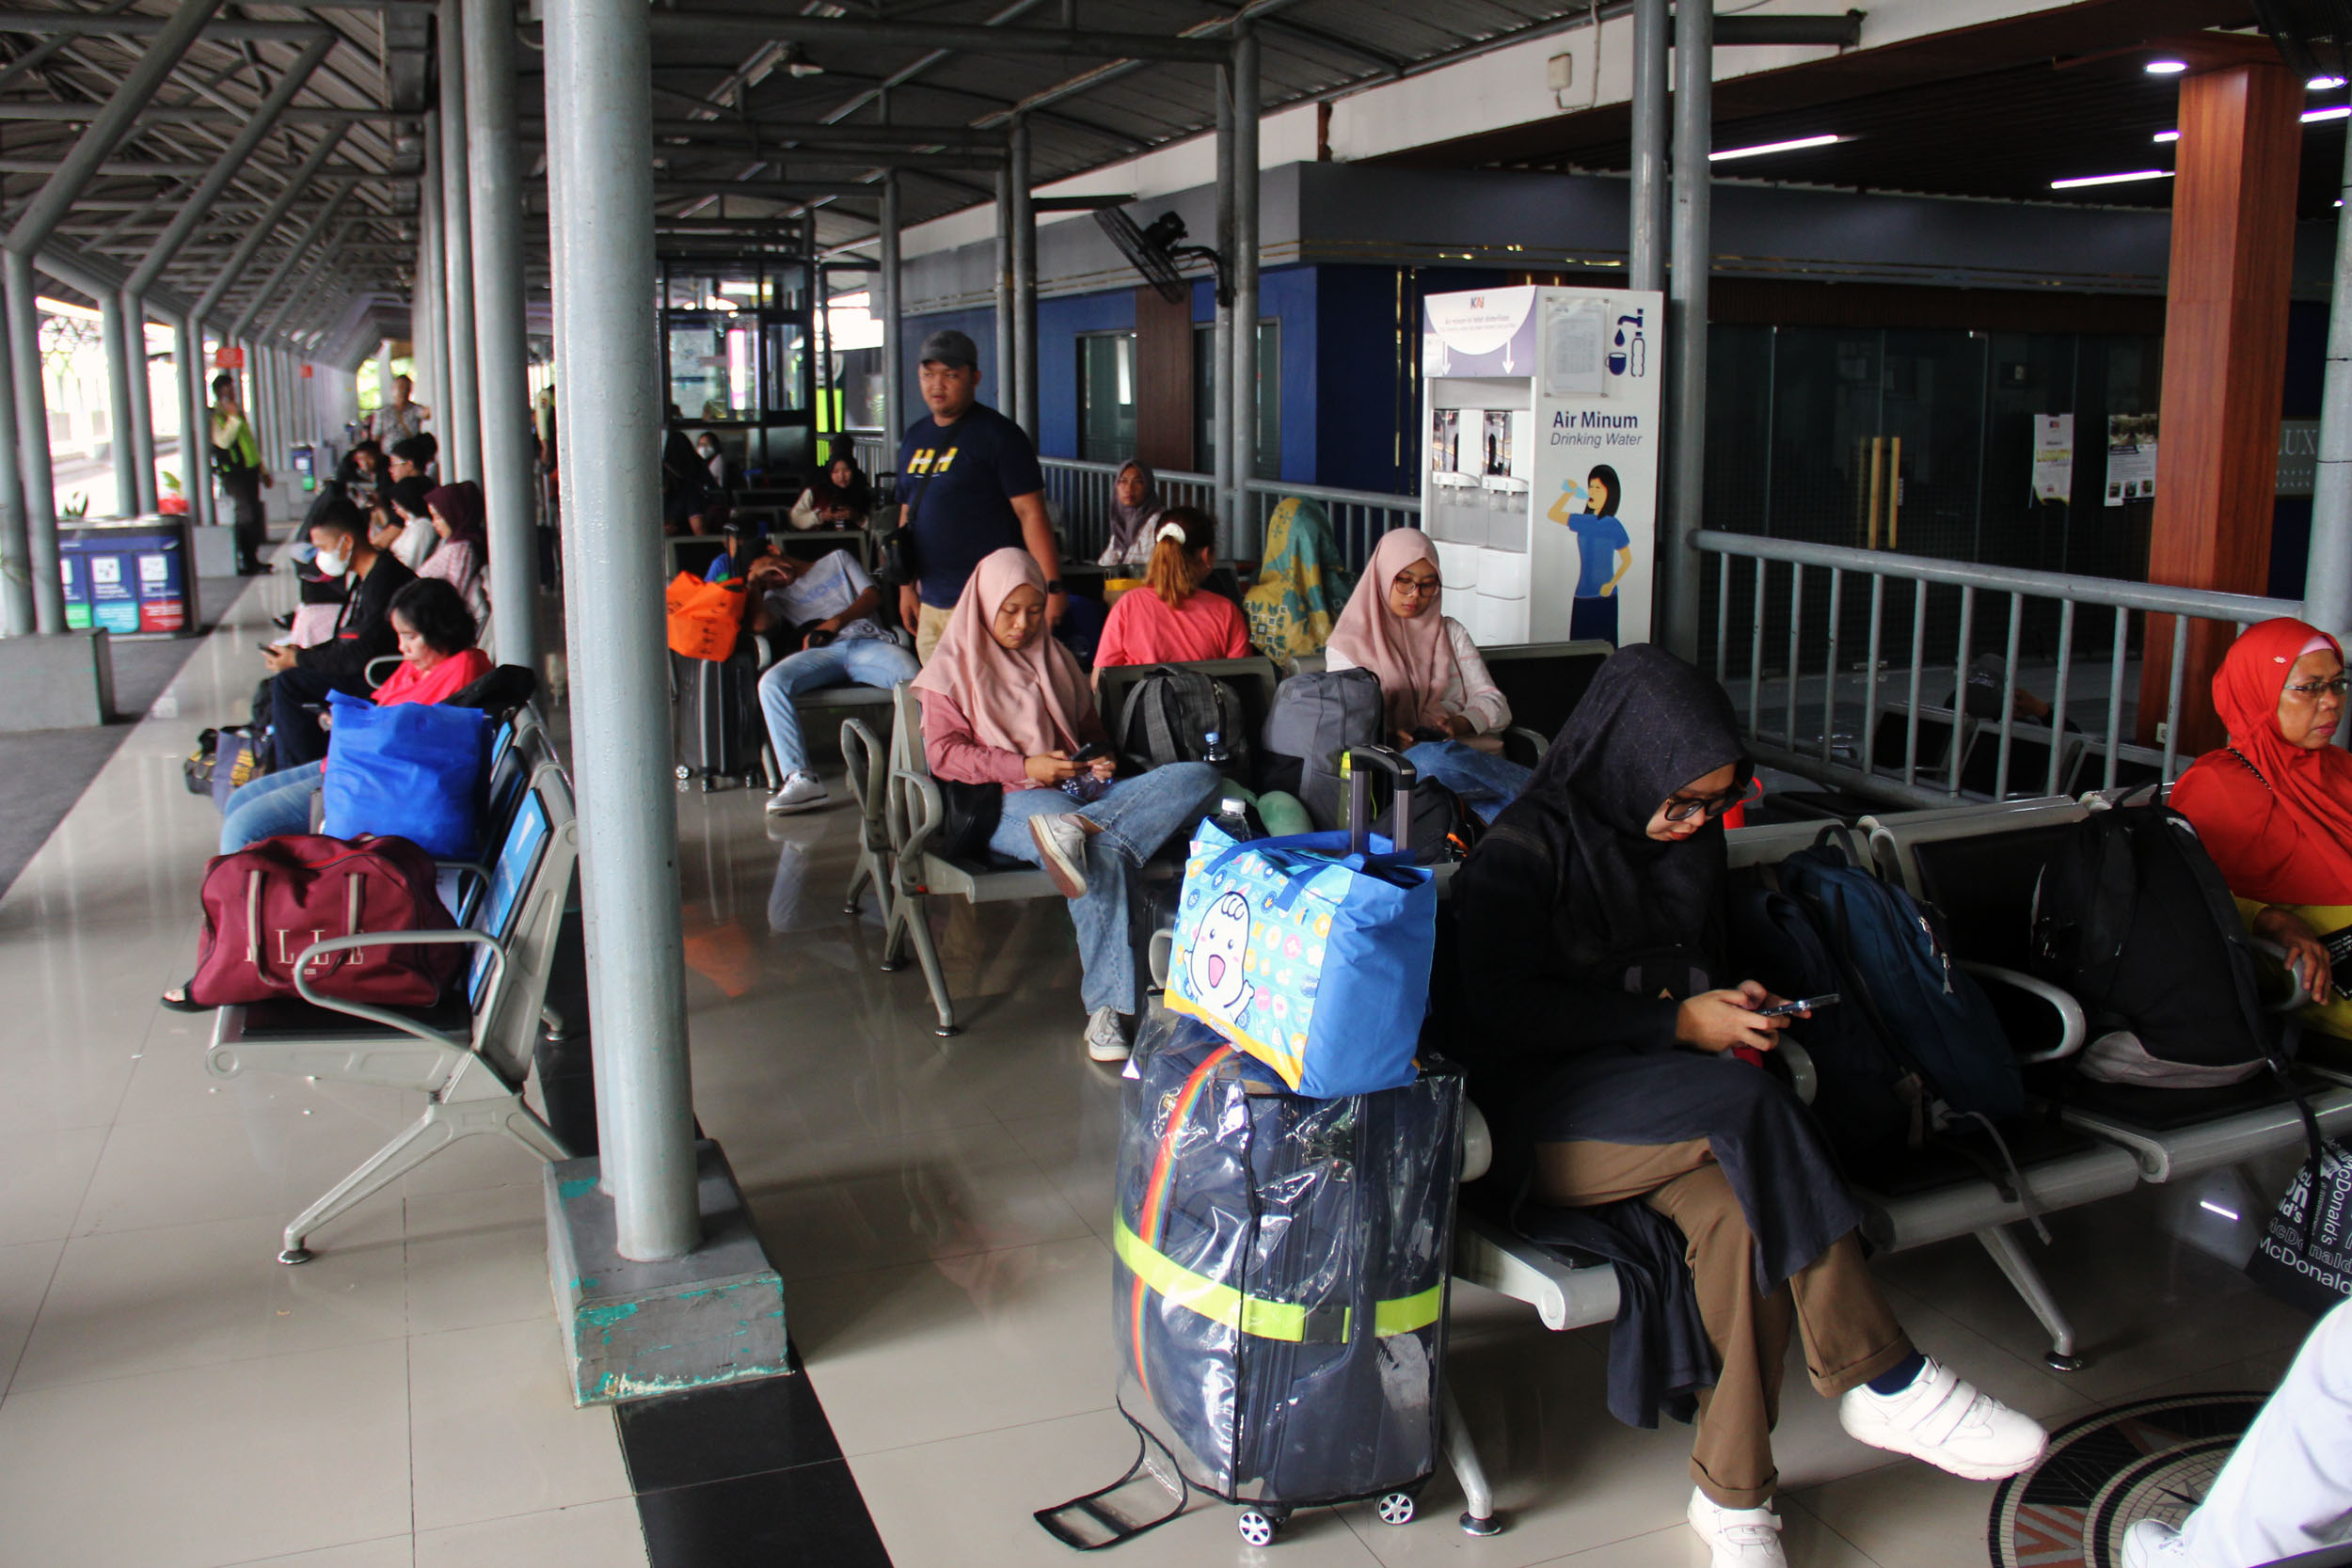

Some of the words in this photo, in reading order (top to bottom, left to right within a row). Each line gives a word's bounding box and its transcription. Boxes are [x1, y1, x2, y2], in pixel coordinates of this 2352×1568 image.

[1552, 410, 1577, 428] Air
[1581, 410, 1639, 429] Minum
[1550, 432, 1602, 449] Drinking
[1606, 432, 1643, 446] Water
[245, 928, 365, 965] LLE
